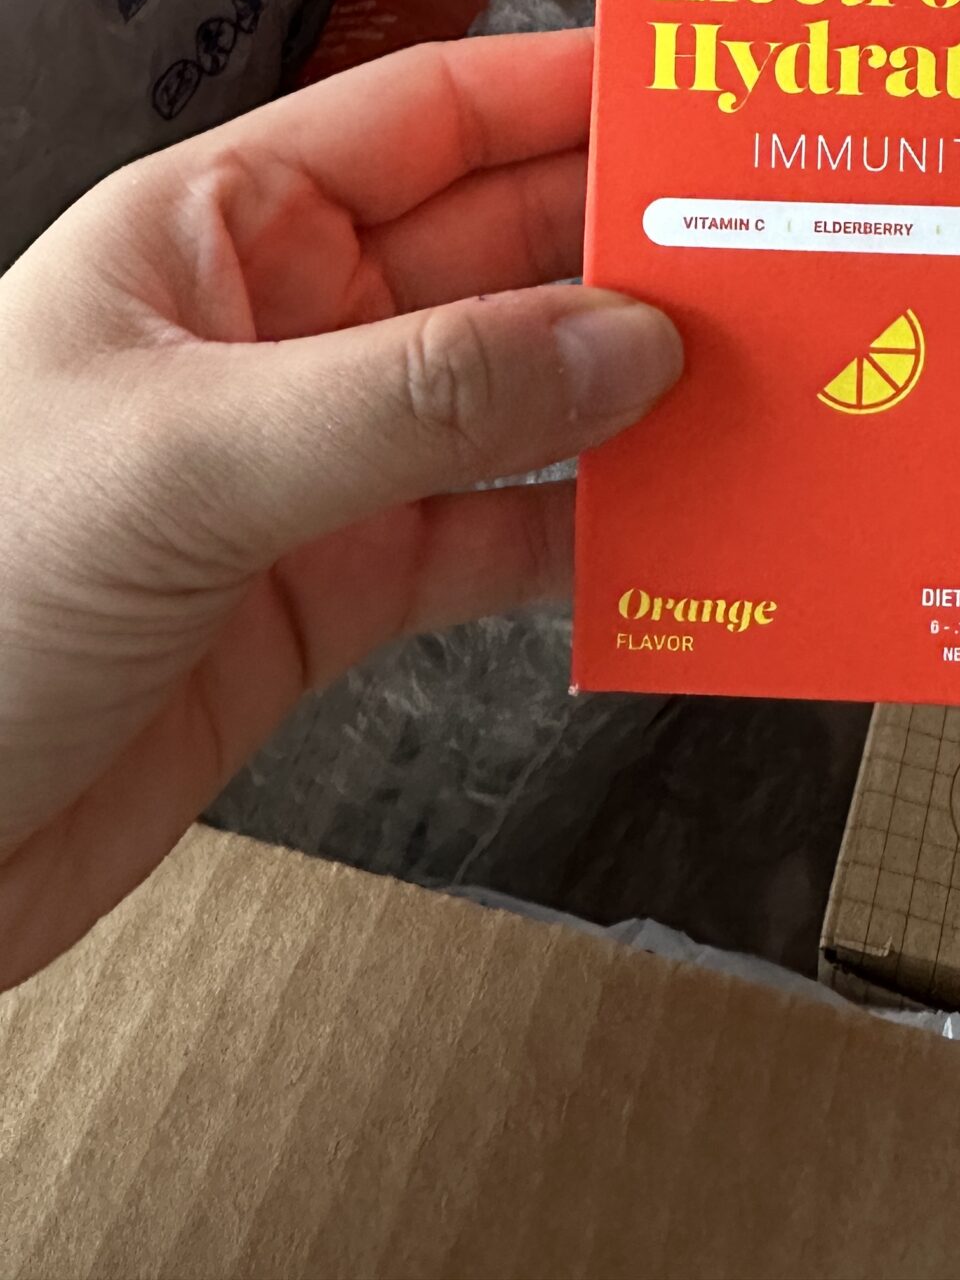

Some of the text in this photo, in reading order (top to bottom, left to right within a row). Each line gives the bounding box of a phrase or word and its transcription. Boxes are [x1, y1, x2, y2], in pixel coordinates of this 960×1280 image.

[684, 217, 764, 231] VITAMIN C
[814, 221, 913, 235] ELDERBERRY
[618, 589, 777, 632] Orange
[931, 620, 939, 634] 6
[617, 633, 693, 651] FLAVOR
